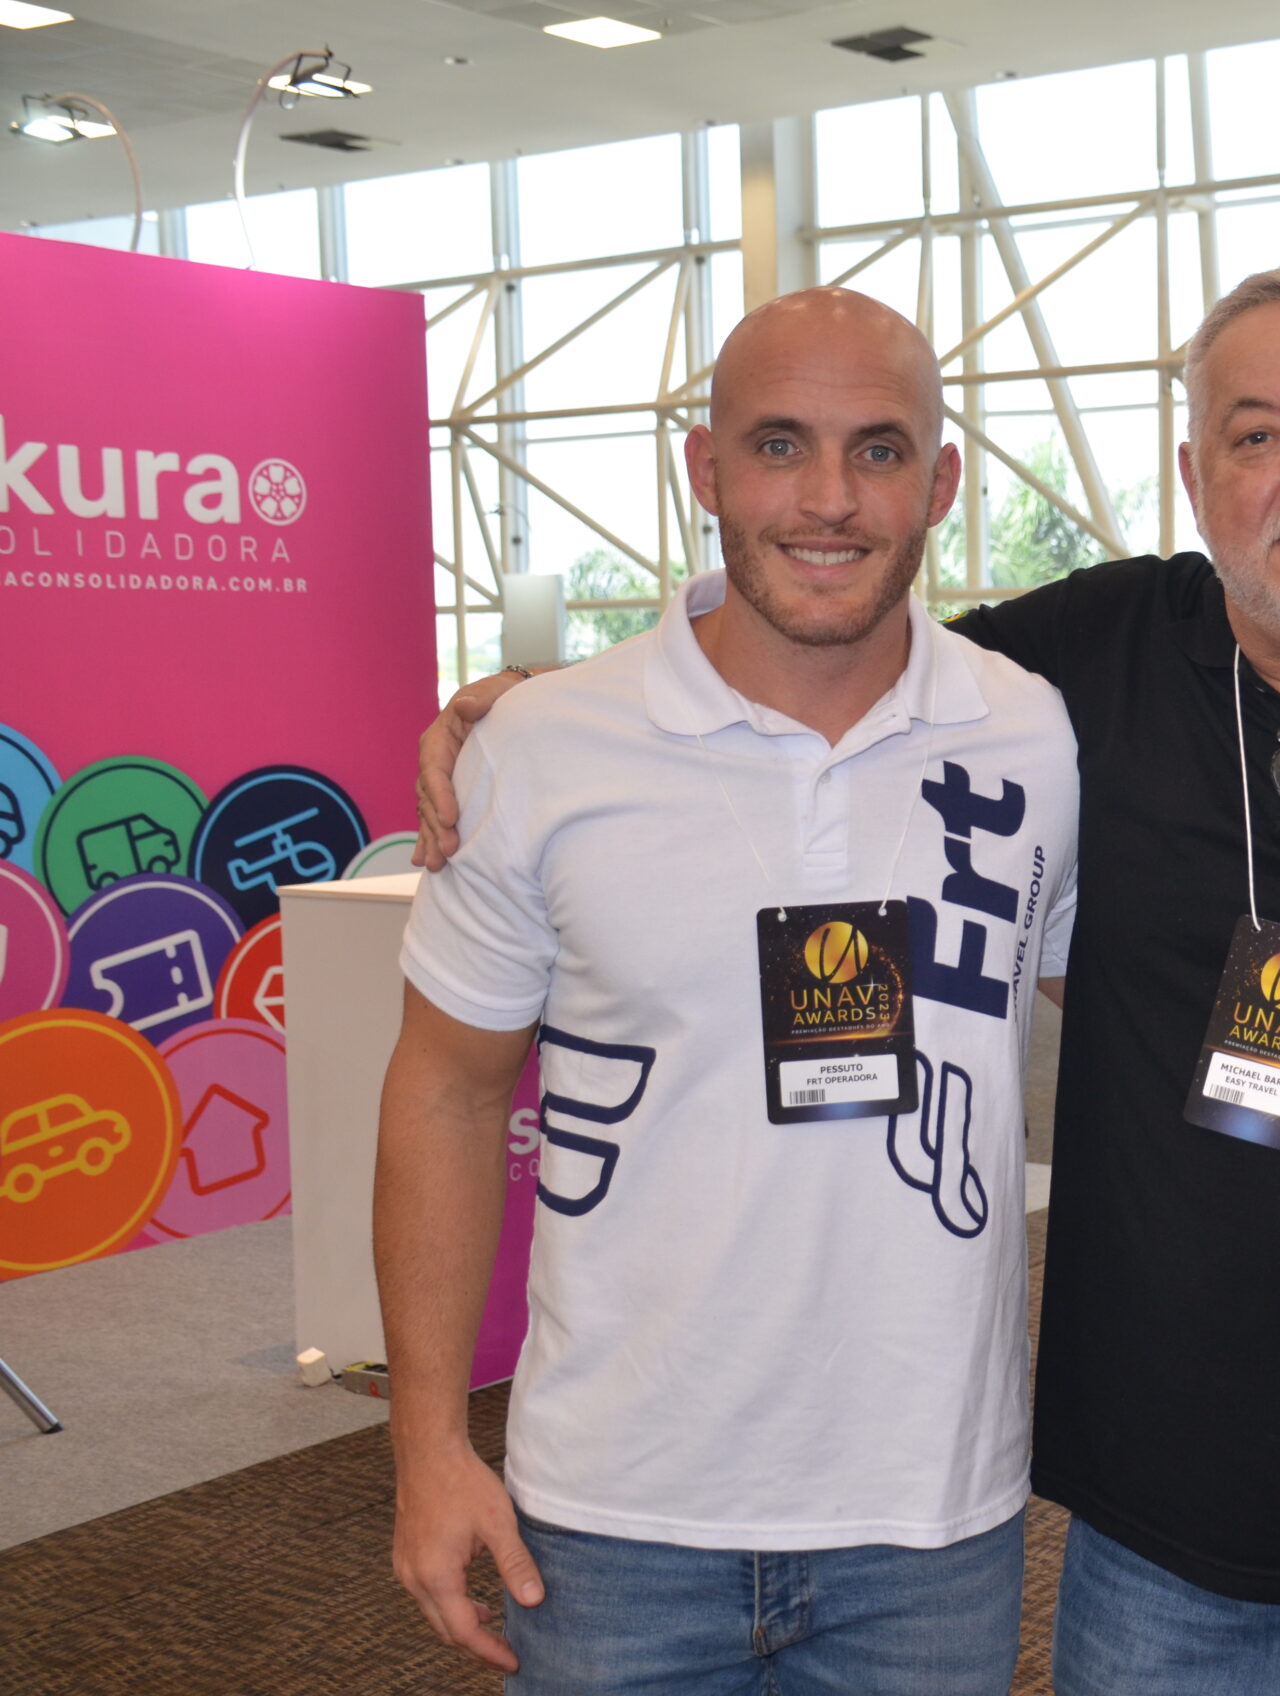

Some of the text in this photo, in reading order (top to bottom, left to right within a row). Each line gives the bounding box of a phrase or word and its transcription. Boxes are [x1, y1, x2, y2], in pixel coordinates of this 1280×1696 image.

[0, 413, 241, 524] kura
[0, 526, 291, 562] OLIDADORA
[1024, 845, 1046, 930] GROUP
[790, 985, 874, 1011] UNAV
[878, 984, 890, 1020] 2023
[793, 1006, 876, 1025] AWARDS
[806, 1073, 878, 1086] FRT OPERADORA
[820, 1063, 863, 1074] PESSUTO
[1220, 1063, 1261, 1081] MICHAEL
[1225, 1076, 1246, 1087] EASY
[1248, 1081, 1278, 1096] TRAVEL
